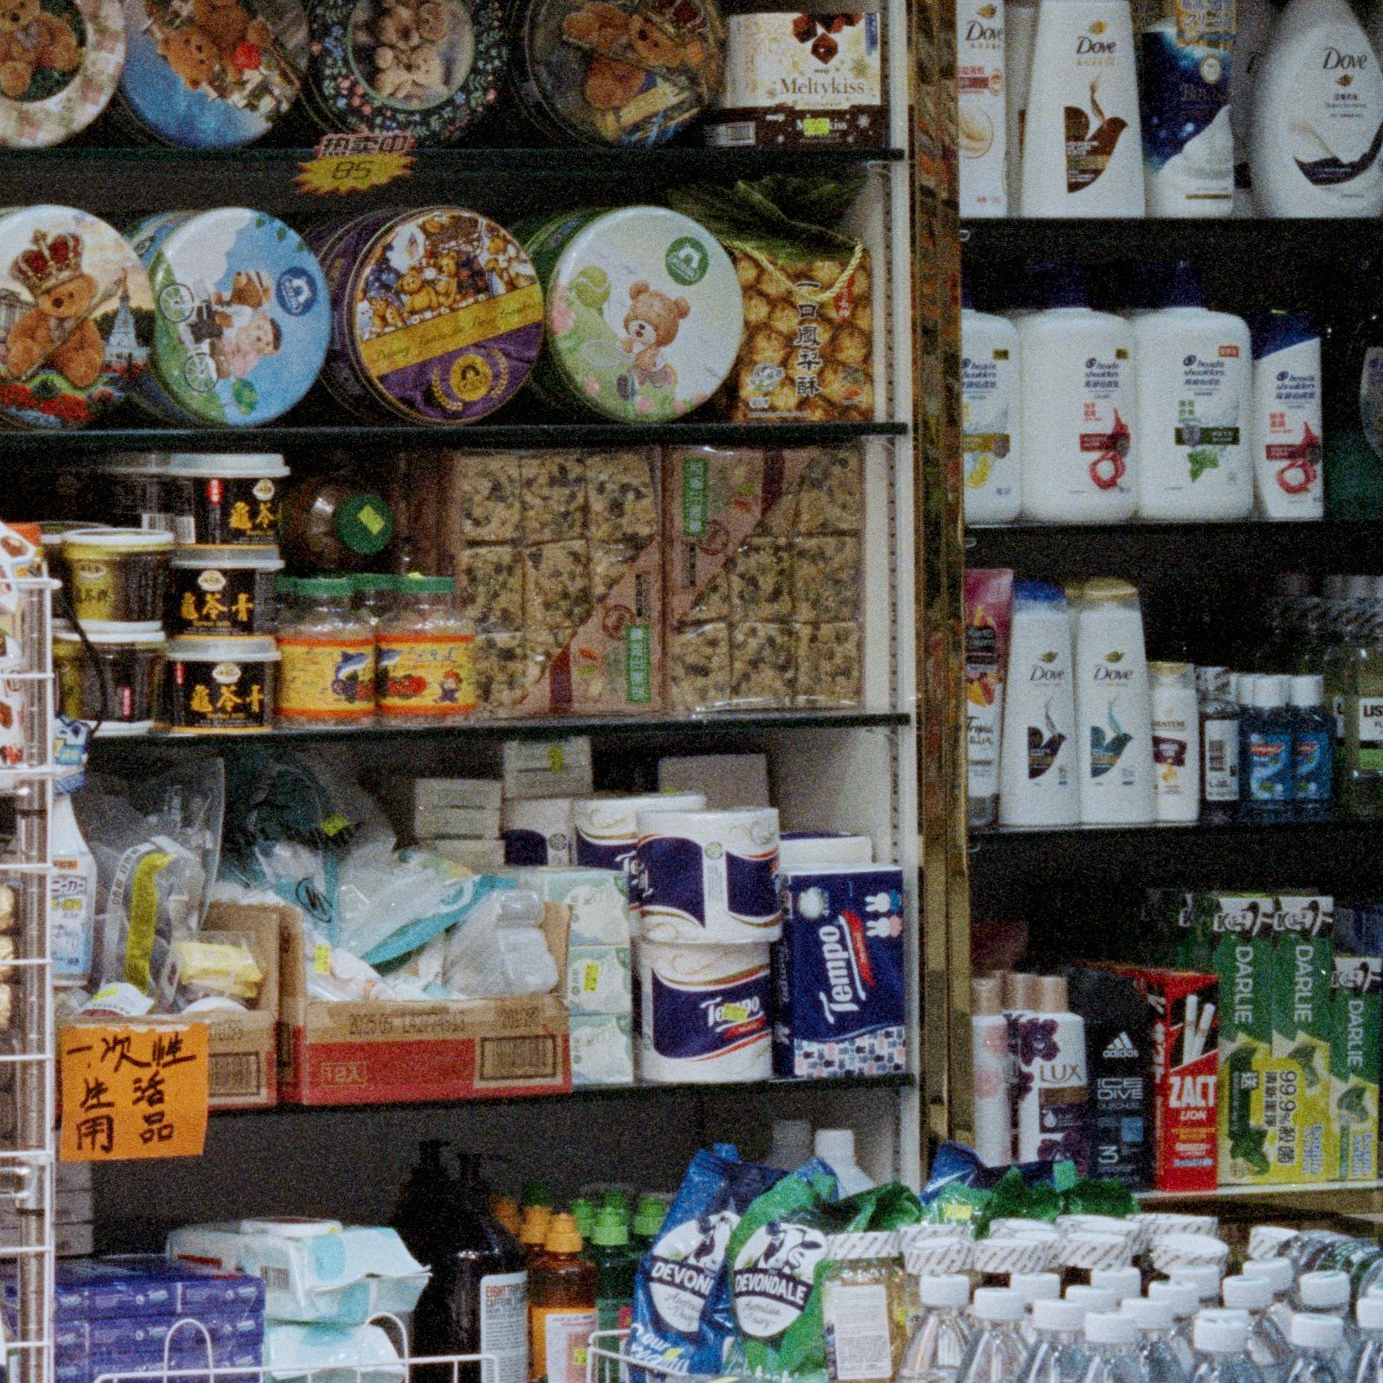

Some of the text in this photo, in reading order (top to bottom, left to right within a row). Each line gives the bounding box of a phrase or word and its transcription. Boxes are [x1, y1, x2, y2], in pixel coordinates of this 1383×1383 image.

[965, 19, 1004, 42] Dove
[1075, 34, 1117, 55] Dove
[1322, 47, 1368, 71] Dove
[780, 76, 866, 100] Meltykiss
[1030, 665, 1066, 682] Dove
[1093, 664, 1134, 682] Dove
[817, 920, 859, 1025] Tempo
[1232, 944, 1255, 1025] DARLIE
[1294, 944, 1313, 1024] DARLIE
[1346, 999, 1365, 1068] DARLIE
[66, 1035, 197, 1073] 一次性
[1102, 1048, 1139, 1059] adidas
[1038, 1064, 1084, 1083] LUX
[1097, 1077, 1143, 1088] ICE
[80, 1074, 167, 1114] 生活
[1168, 1075, 1218, 1108] ZACT
[1180, 1111, 1207, 1120] LION
[75, 1112, 175, 1154] 用品
[1097, 1145, 1119, 1163] 3
[734, 1273, 808, 1306] DEVONDALE
